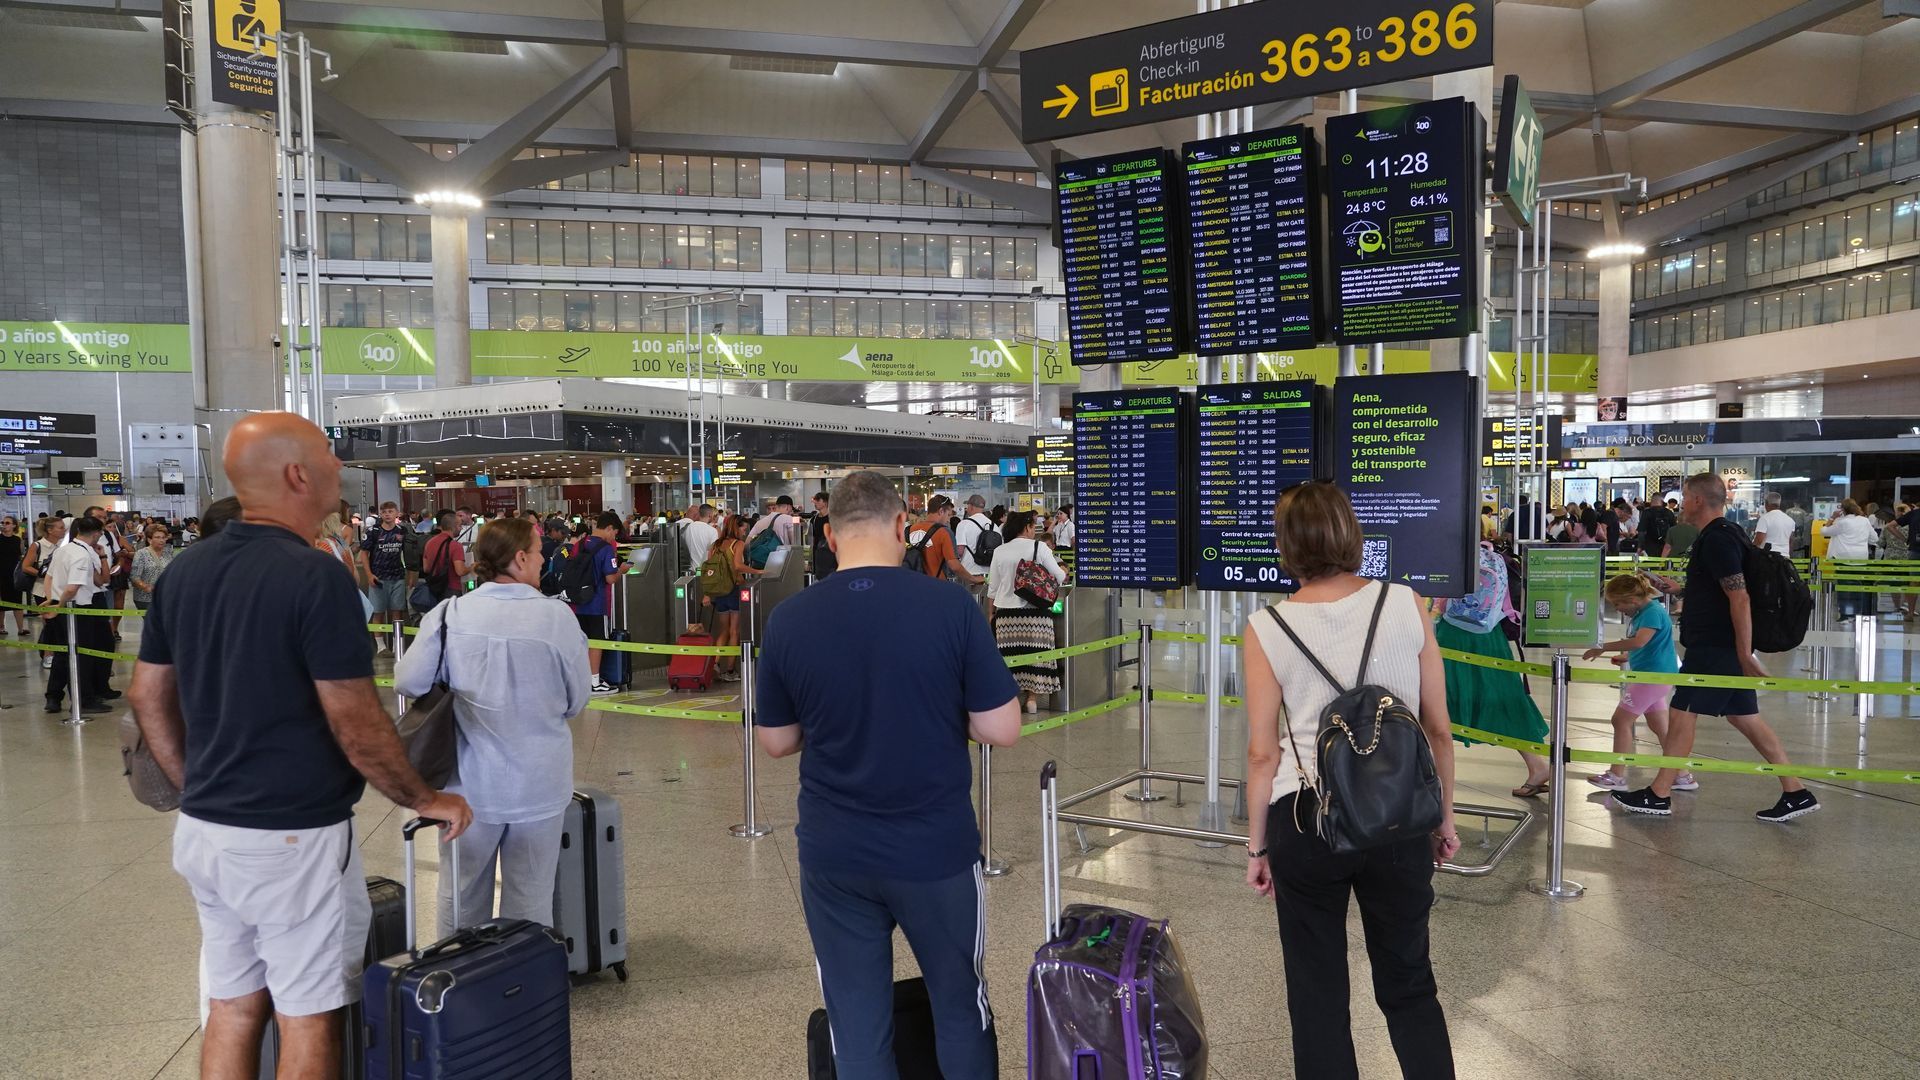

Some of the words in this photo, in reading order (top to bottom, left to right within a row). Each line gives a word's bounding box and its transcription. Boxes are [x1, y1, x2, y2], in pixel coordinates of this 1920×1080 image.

[1356, 25, 1372, 41] to
[1140, 33, 1225, 61] Abfertigung
[1140, 70, 1254, 106] Facturación
[1260, 27, 1352, 83] 363
[1358, 51, 1370, 67] a
[1376, 2, 1478, 63] 386
[224, 61, 252, 74] Security
[1140, 58, 1200, 82] Check-in
[228, 71, 260, 83] Control
[263, 78, 273, 86] de
[230, 81, 273, 95] seguridad
[1416, 122, 1430, 130] 100
[1248, 136, 1297, 151] DEPARTURES
[1113, 159, 1157, 172] DEPARTURES
[1366, 152, 1428, 179] 11:28
[1410, 178, 1446, 190] Humedad
[1342, 186, 1388, 198] Temperatura
[13, 329, 56, 343] años
[632, 339, 662, 353] 100
[14, 350, 61, 364] Years
[68, 351, 130, 368] Serving
[138, 352, 168, 365] You
[363, 344, 395, 362] 100
[865, 353, 893, 361] aena
[969, 346, 1002, 368] 100
[632, 359, 660, 372] 100
[772, 360, 798, 374] You
[1129, 397, 1171, 406] DEPARTURES
[1263, 390, 1302, 400] SALIDAS
[1353, 394, 1382, 403] Aena,
[1353, 404, 1428, 417] comprometida
[1353, 421, 1370, 429] con
[1373, 419, 1382, 428] el
[1386, 418, 1438, 428] desarrollo
[1352, 434, 1391, 444] seguro,
[1394, 432, 1425, 441] eficaz
[1580, 436, 1600, 445] THE
[1606, 435, 1654, 444] FASHION
[1658, 434, 1706, 443] GALLERY
[1352, 448, 1358, 458] y
[1361, 446, 1416, 455] sostenible
[1352, 460, 1368, 469] del
[1371, 460, 1427, 470] transporte
[1352, 473, 1384, 482] aéreo.
[1224, 566, 1243, 580] 05
[1259, 567, 1278, 581] 00
